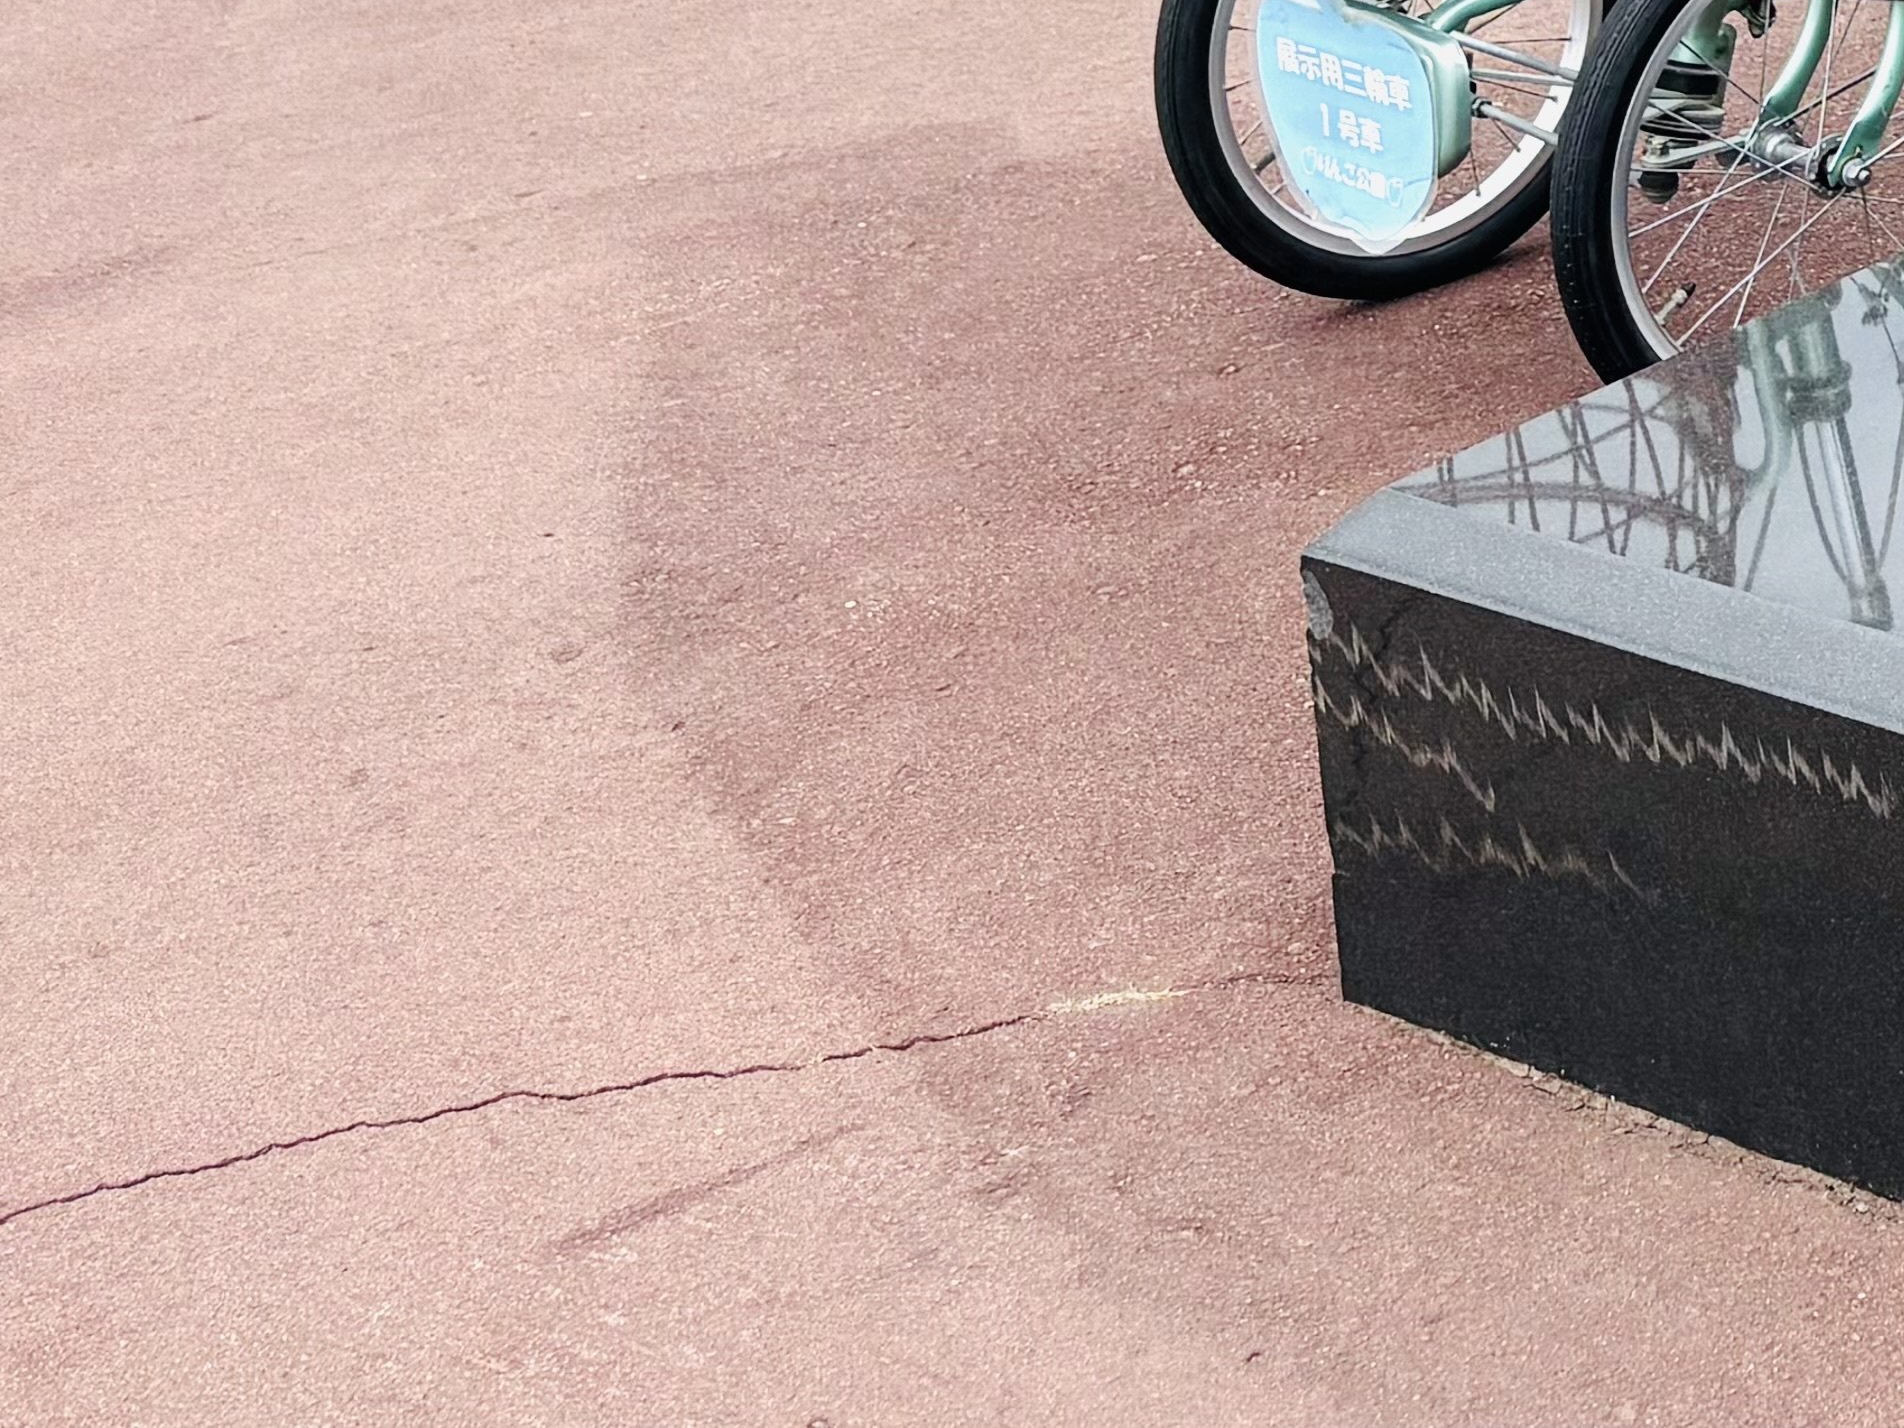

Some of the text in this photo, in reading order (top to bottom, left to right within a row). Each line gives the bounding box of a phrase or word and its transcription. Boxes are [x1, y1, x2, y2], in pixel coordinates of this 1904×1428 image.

[1277, 38, 1412, 110] 展示用三輪車
